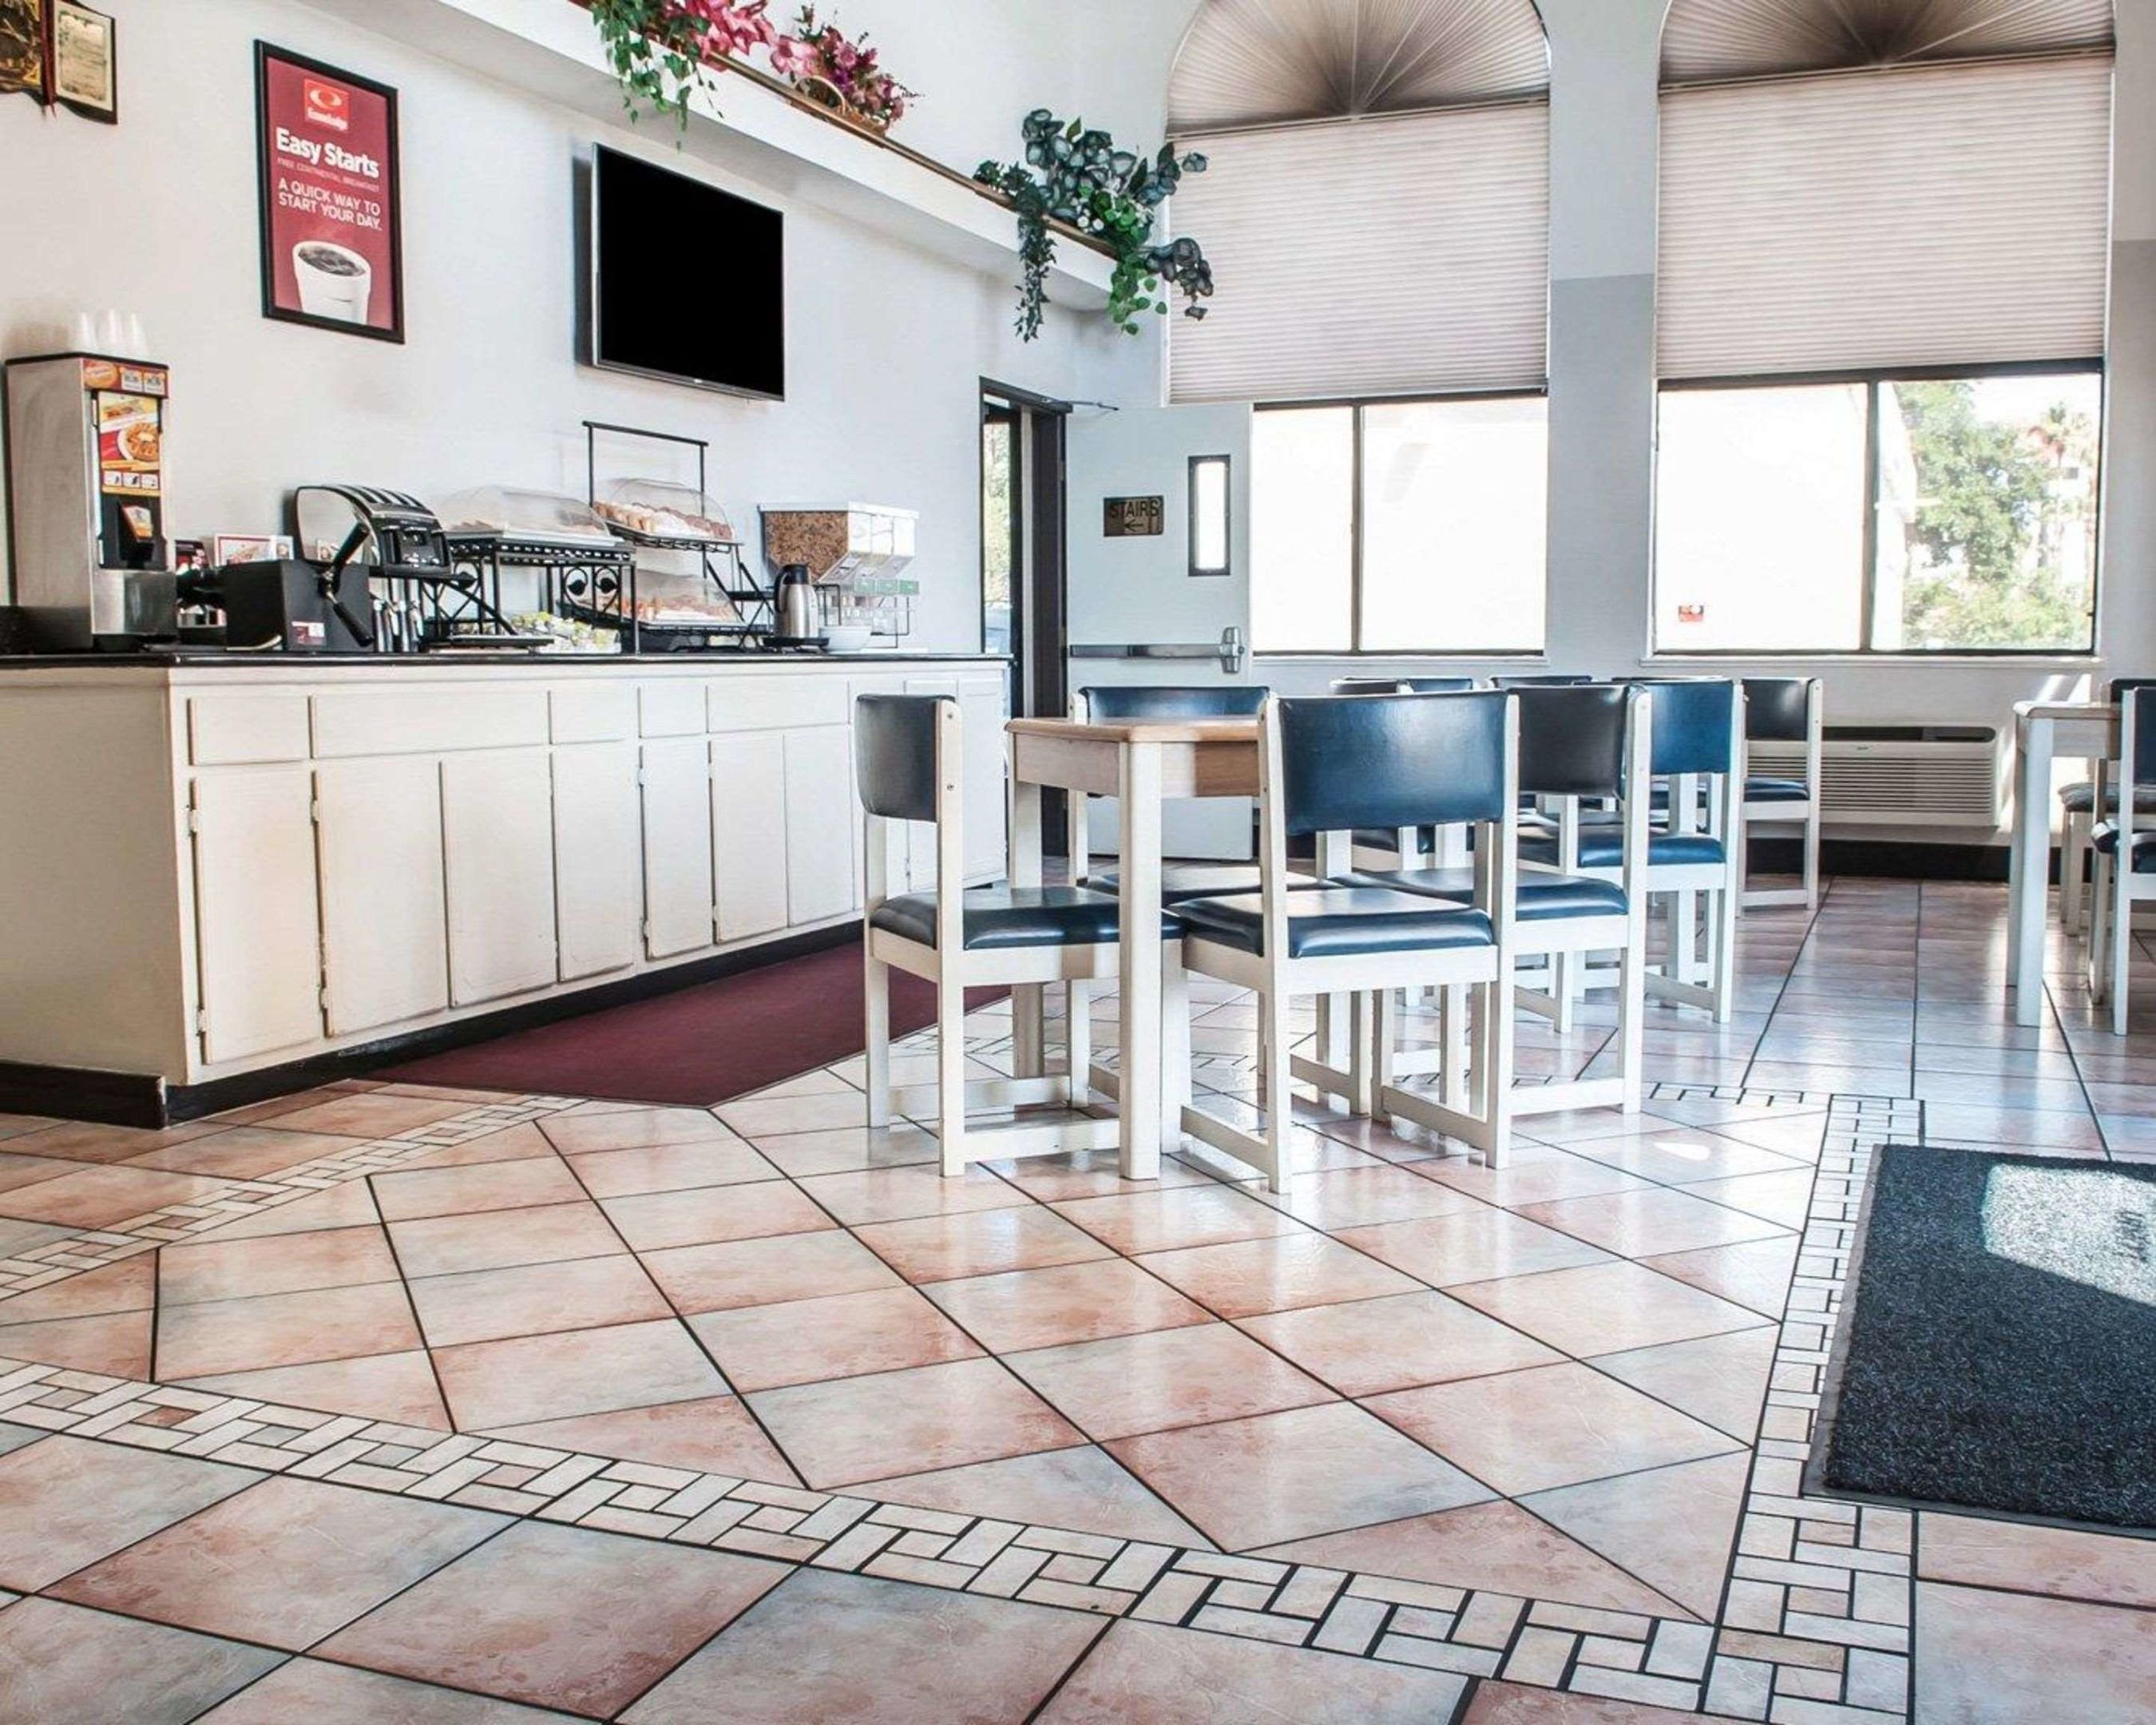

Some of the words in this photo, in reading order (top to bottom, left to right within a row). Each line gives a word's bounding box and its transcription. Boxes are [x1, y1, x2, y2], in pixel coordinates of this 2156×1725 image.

[276, 126, 322, 165] Easy
[324, 142, 379, 178] Starts
[279, 177, 288, 192] A
[291, 180, 331, 203] QUICK
[333, 192, 361, 210] WAY
[364, 200, 381, 216] TO
[279, 192, 317, 213] START
[320, 203, 354, 223] YOUR
[356, 212, 382, 231] DAY.
[1108, 499, 1160, 518] STAIRS
